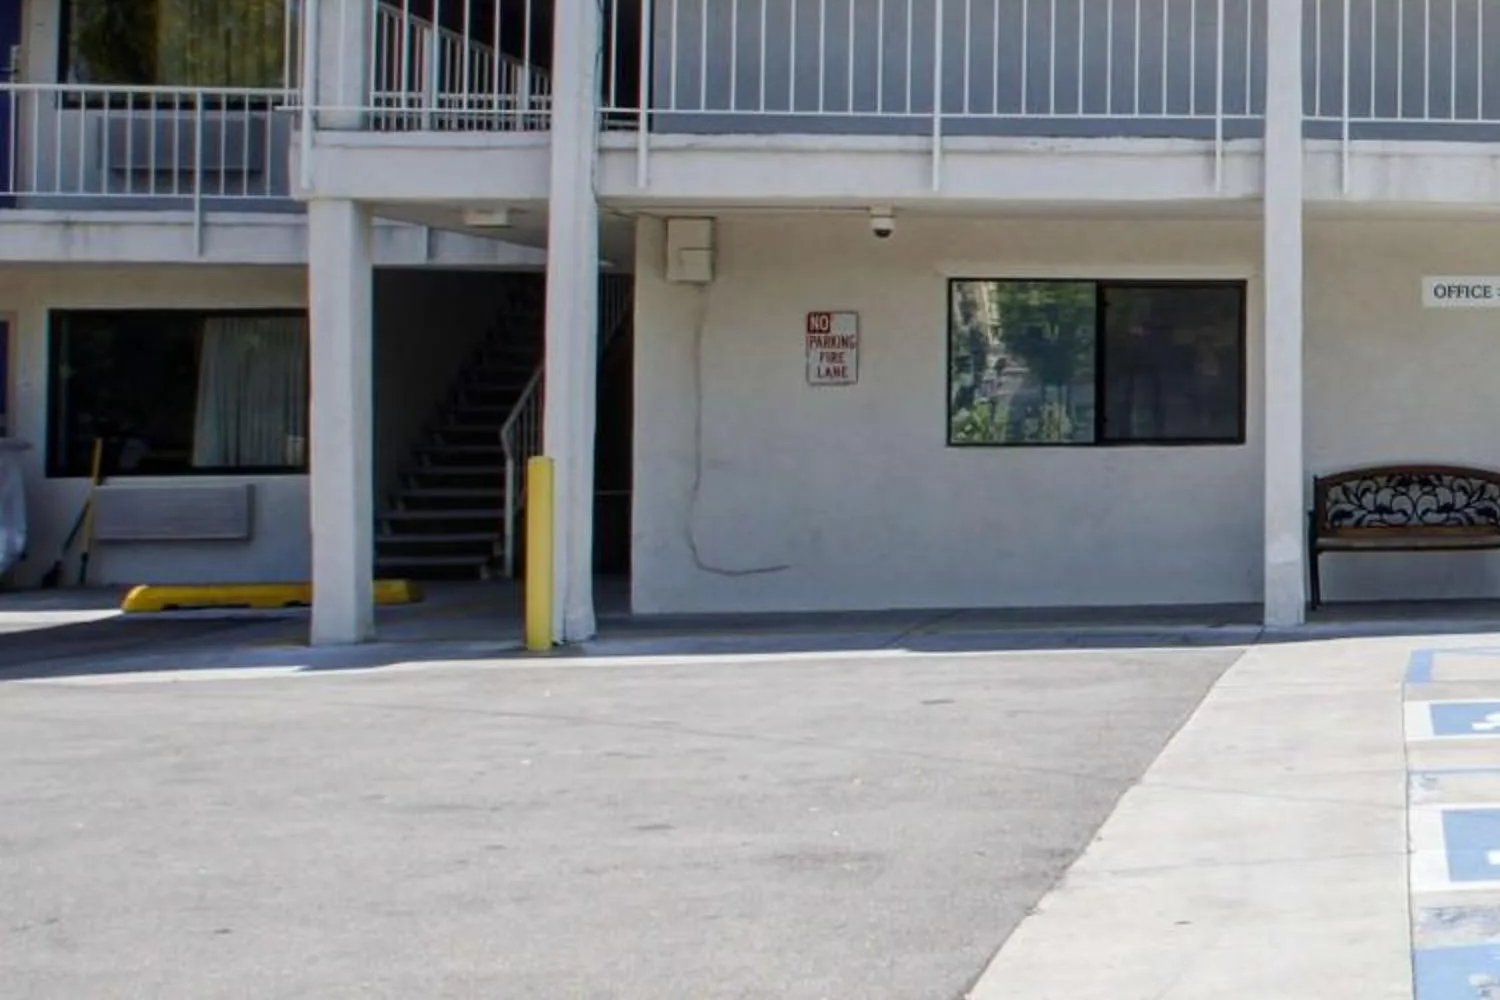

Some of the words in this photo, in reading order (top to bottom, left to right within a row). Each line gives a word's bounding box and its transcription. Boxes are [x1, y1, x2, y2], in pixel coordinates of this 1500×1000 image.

[1433, 283, 1494, 299] OFFICE
[810, 315, 829, 331] NO
[809, 334, 856, 349] PARKING
[820, 352, 845, 363] FIRE
[817, 366, 848, 378] LANE
